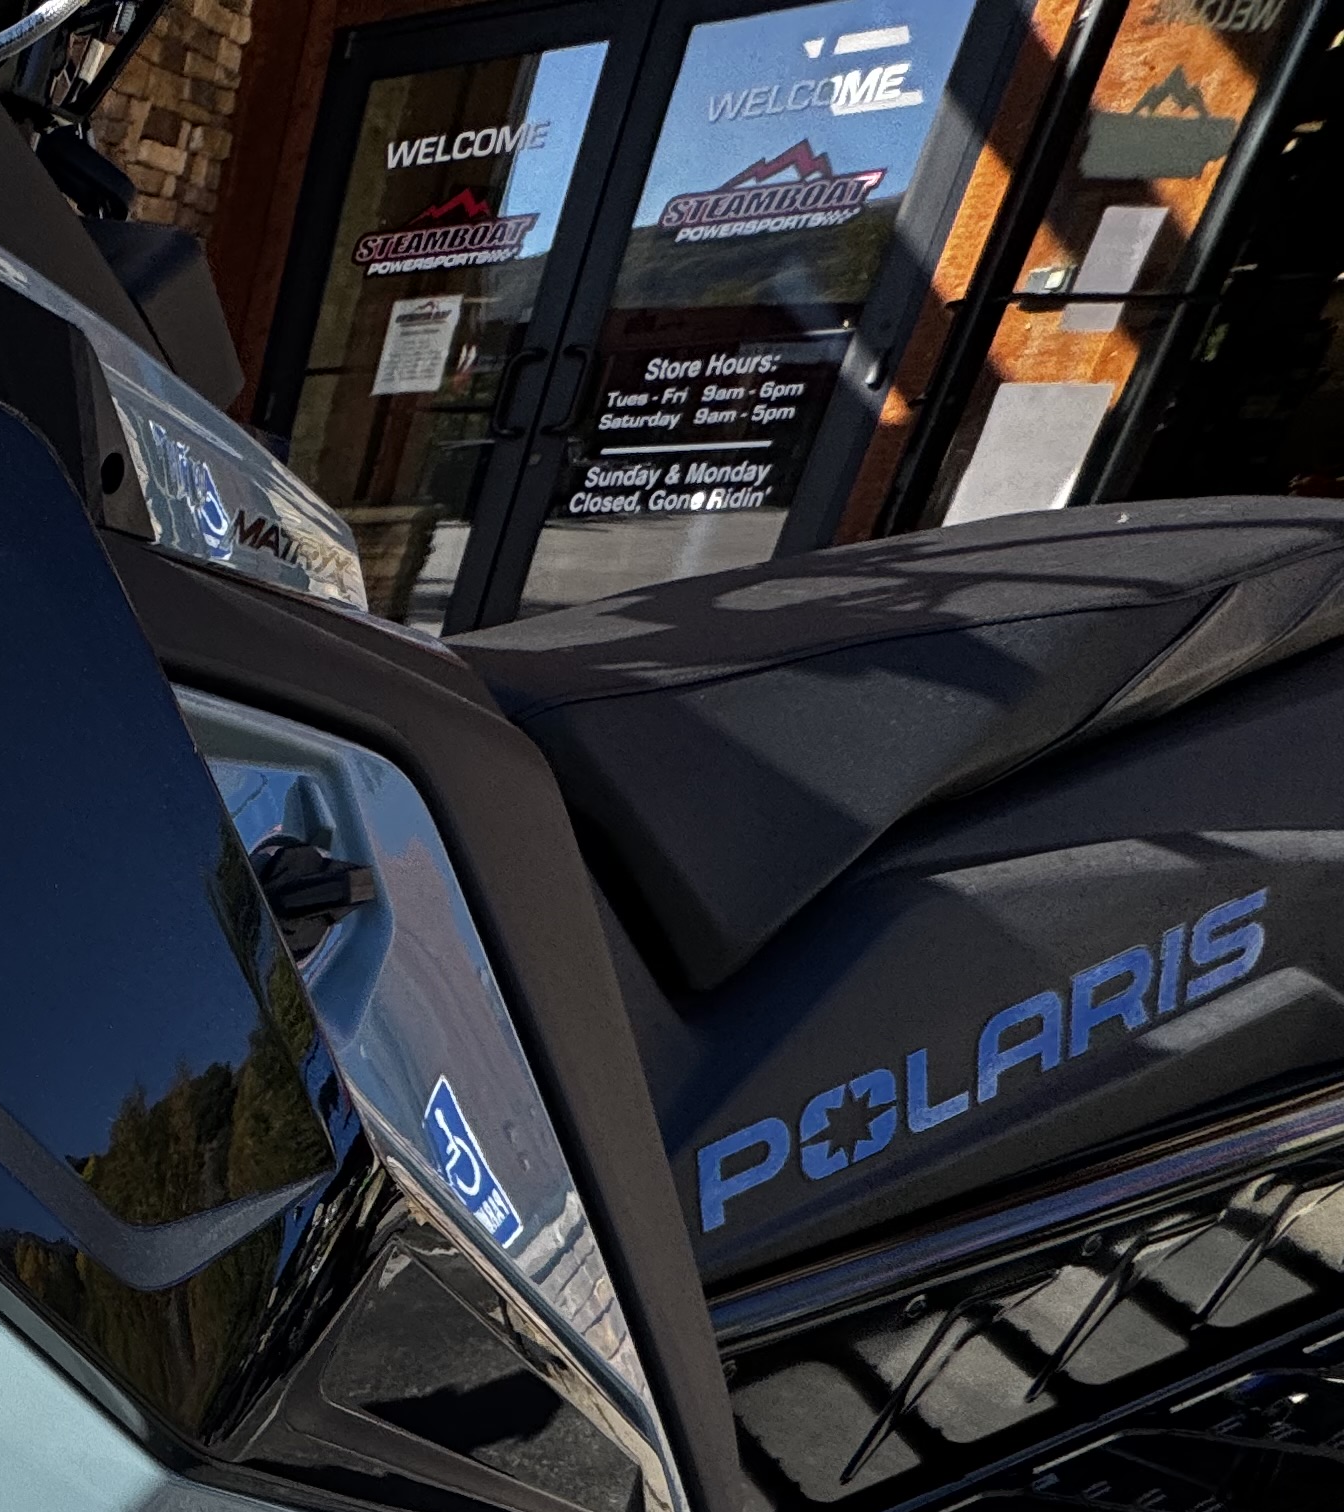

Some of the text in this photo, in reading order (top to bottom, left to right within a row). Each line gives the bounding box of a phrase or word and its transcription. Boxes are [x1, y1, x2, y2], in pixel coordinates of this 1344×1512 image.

[709, 63, 911, 122] WELCOME
[386, 121, 550, 169] WELCOME
[662, 171, 885, 227] STEAMBOAT
[355, 215, 536, 262] STEAMBOAT
[675, 211, 824, 242] POWERSPORTS
[367, 249, 493, 276] POWERSPORTS
[645, 353, 781, 380] Store Hours:
[608, 391, 648, 407] Tues
[661, 387, 689, 404] Fri
[701, 385, 744, 402] 9am
[759, 381, 804, 401] 6pm
[599, 410, 683, 430] Saturday
[693, 408, 737, 425] 9am
[751, 404, 796, 424] 5pm
[585, 460, 774, 490] Sunday & Monday
[569, 491, 642, 514] Closed,
[648, 490, 704, 511] Gone
[696, 886, 1268, 1233] POLARIS
